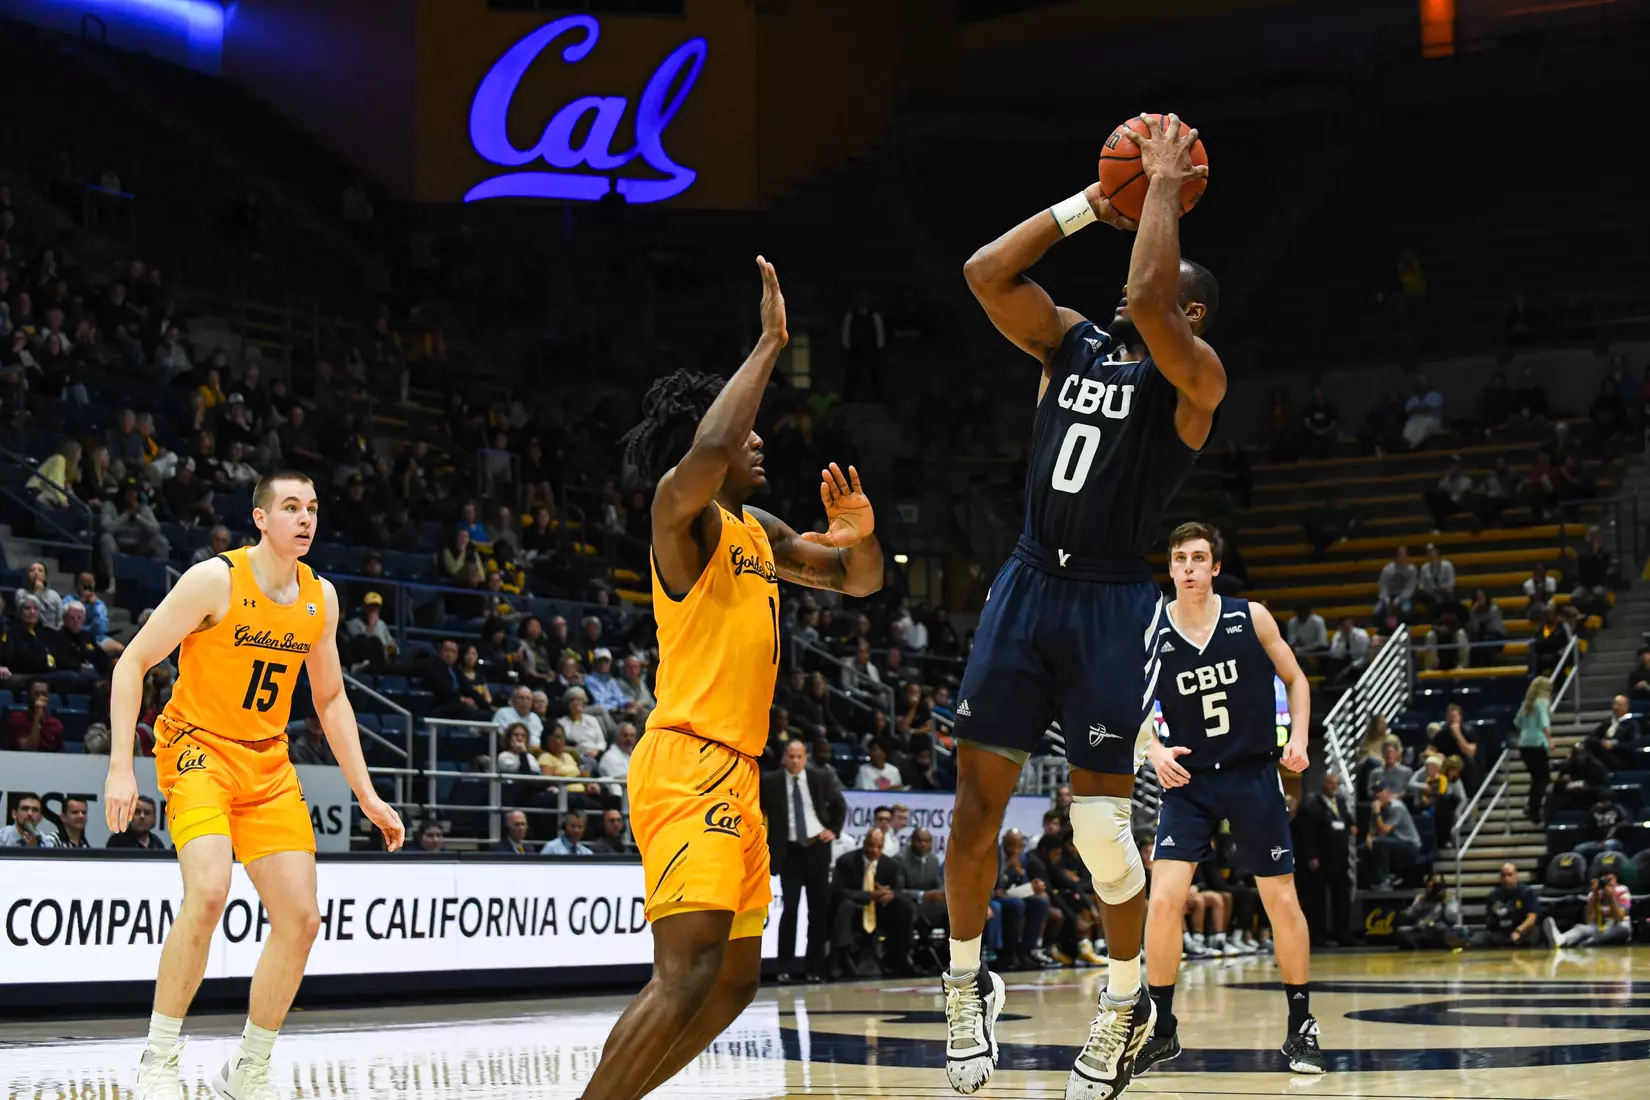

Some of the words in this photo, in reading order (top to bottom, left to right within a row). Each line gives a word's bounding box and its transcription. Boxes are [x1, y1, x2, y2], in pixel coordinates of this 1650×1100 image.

[463, 13, 708, 205] Cal
[1057, 373, 1135, 419] CBU
[1051, 422, 1101, 494] 0
[729, 545, 764, 577] Golde
[234, 624, 279, 647] Golden
[768, 596, 778, 665] 1
[1225, 624, 1243, 635] WAC
[242, 659, 288, 713] 15
[1175, 659, 1239, 696] CBU
[1201, 691, 1230, 738] 5
[176, 749, 207, 776] Cal
[6, 898, 181, 947] COMPAN
[320, 898, 356, 941] HE
[366, 896, 558, 941] CALIFORNIA
[568, 896, 647, 935] GOLD
[1365, 908, 1396, 935] Cal
